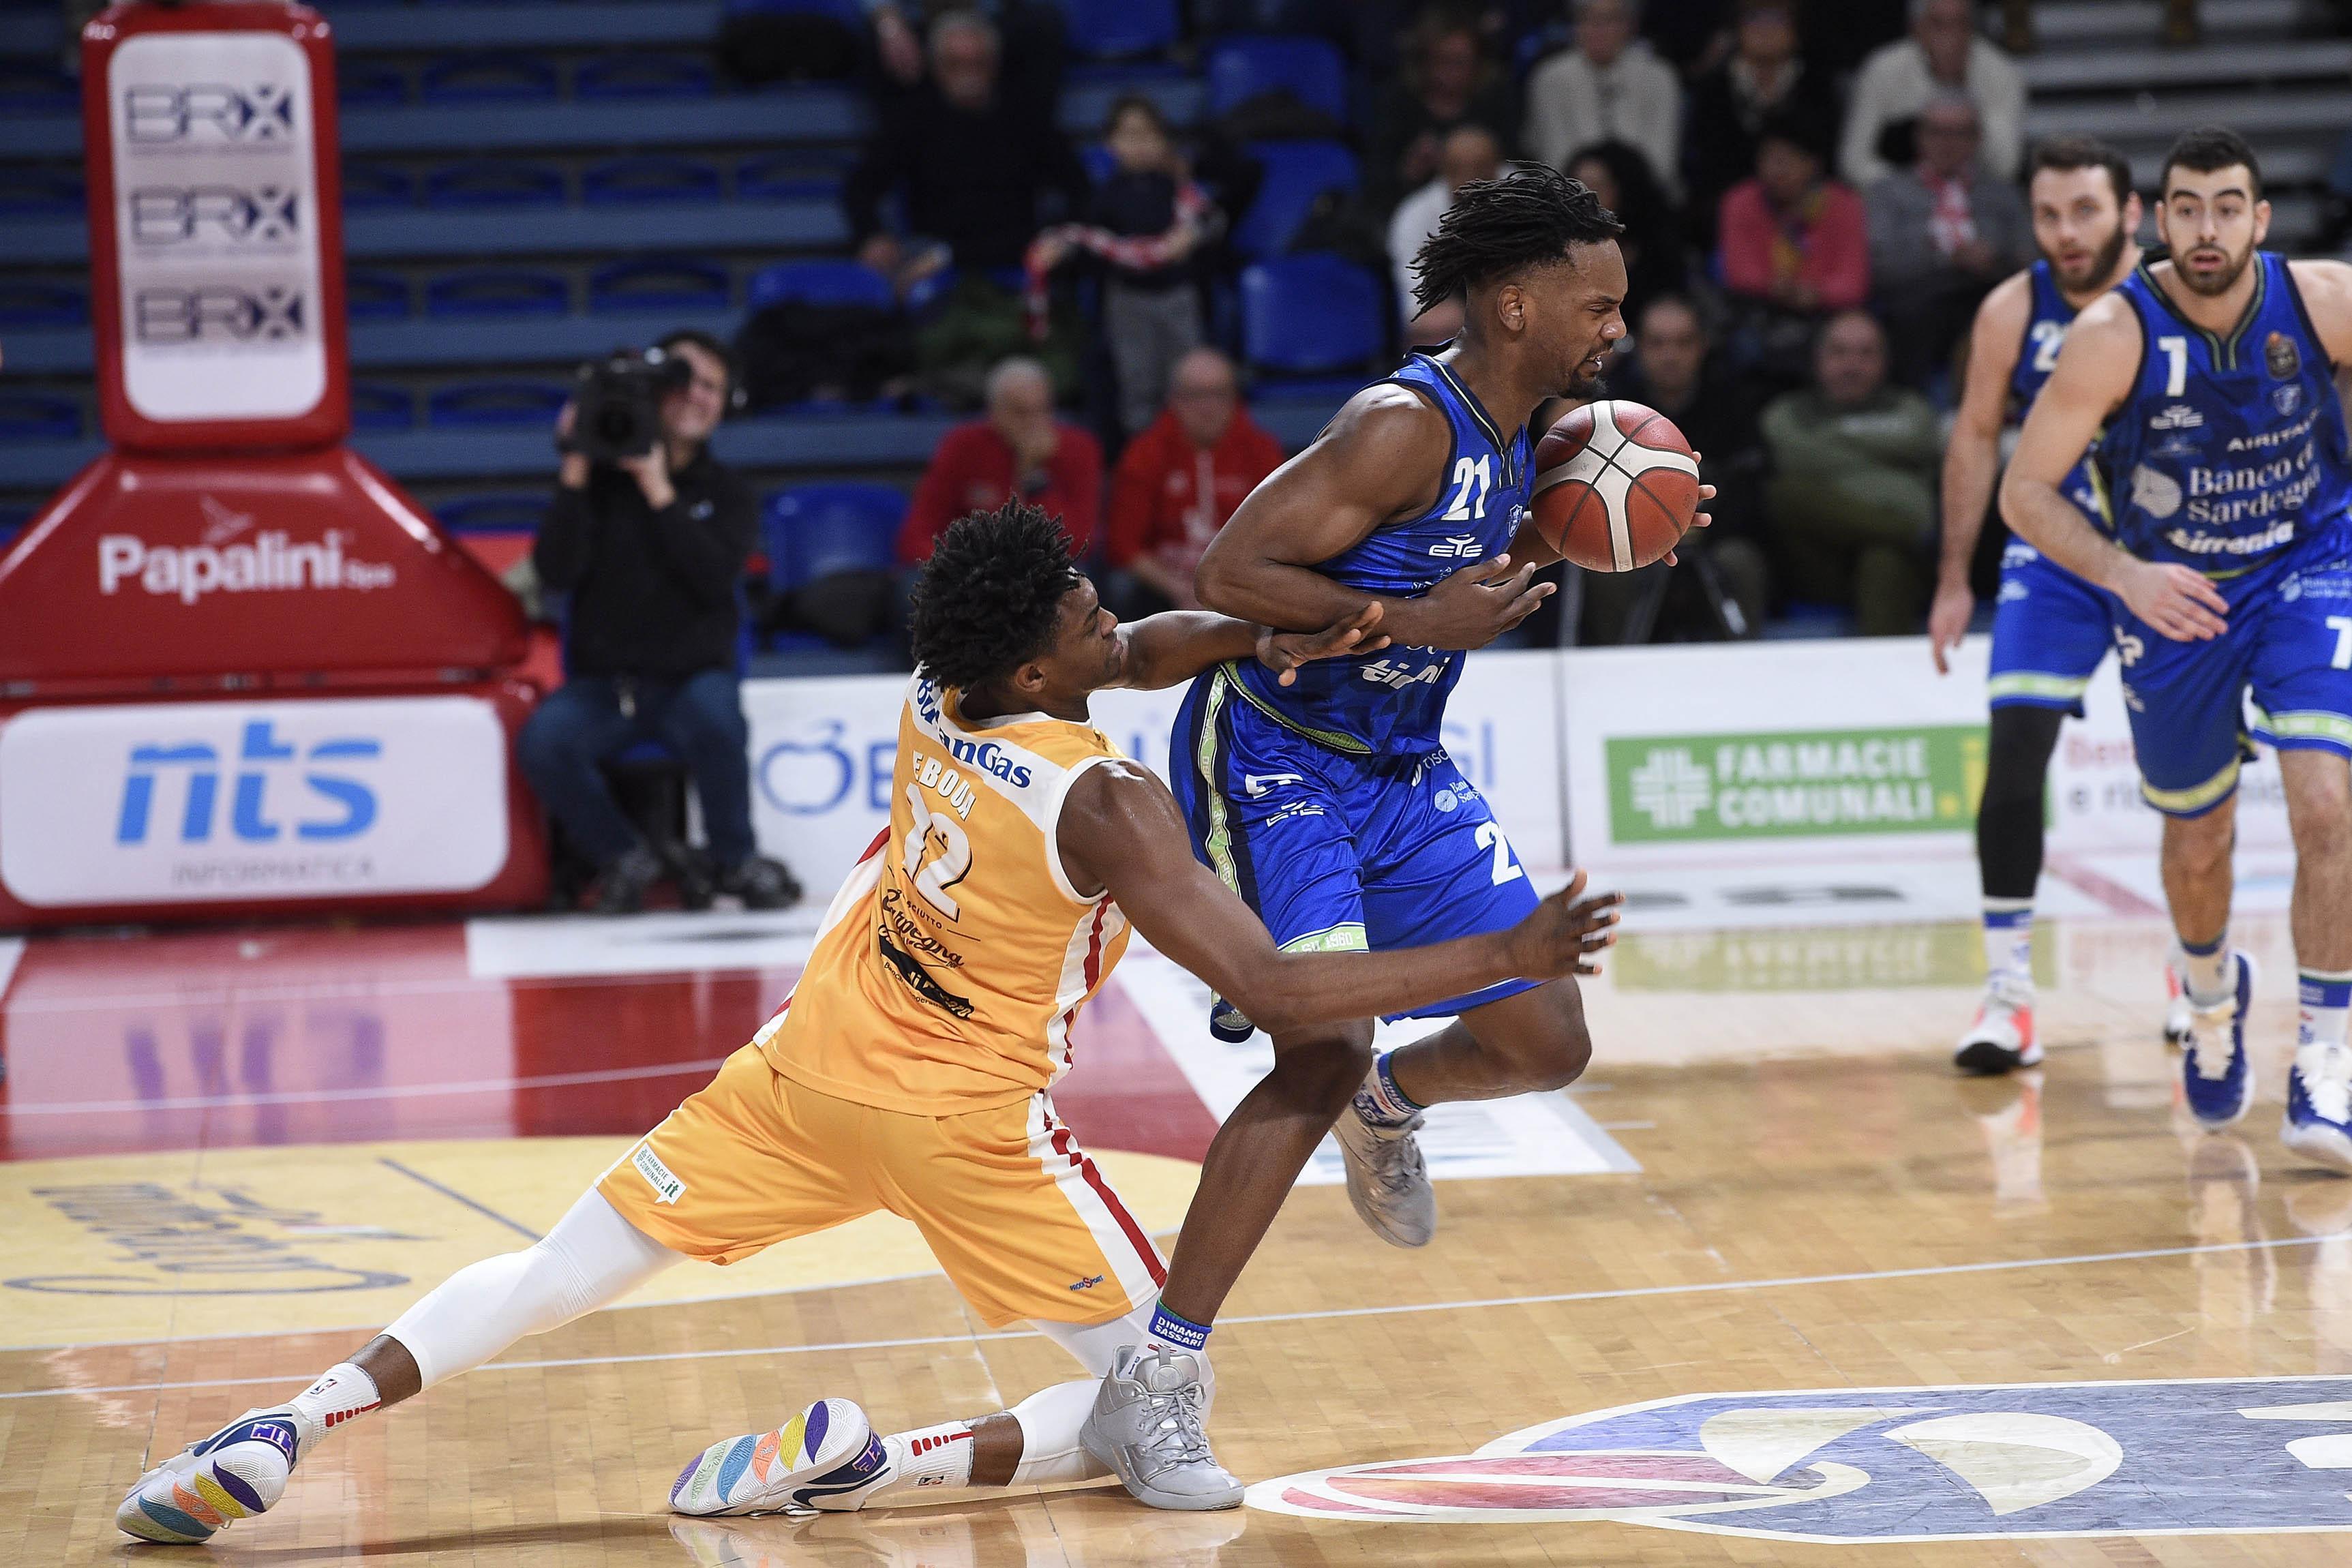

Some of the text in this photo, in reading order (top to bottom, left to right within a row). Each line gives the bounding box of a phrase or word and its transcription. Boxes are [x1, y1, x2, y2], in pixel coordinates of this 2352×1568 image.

[2031, 319, 2068, 372] 2
[1441, 454, 1490, 520] 21
[2190, 457, 2292, 497] Banco
[99, 529, 342, 605] Papalini
[1715, 738, 1929, 783] FARMACIE
[117, 721, 384, 847] nts
[913, 750, 976, 821] EBOUA
[1717, 783, 1935, 827] COMUNALI
[901, 782, 973, 923] 12
[639, 1161, 663, 1187] COMUNALI
[646, 1154, 669, 1180] FARMACIE
[1154, 1325, 1203, 1348] SASSARI
[1158, 1316, 1205, 1340] DINAMO
